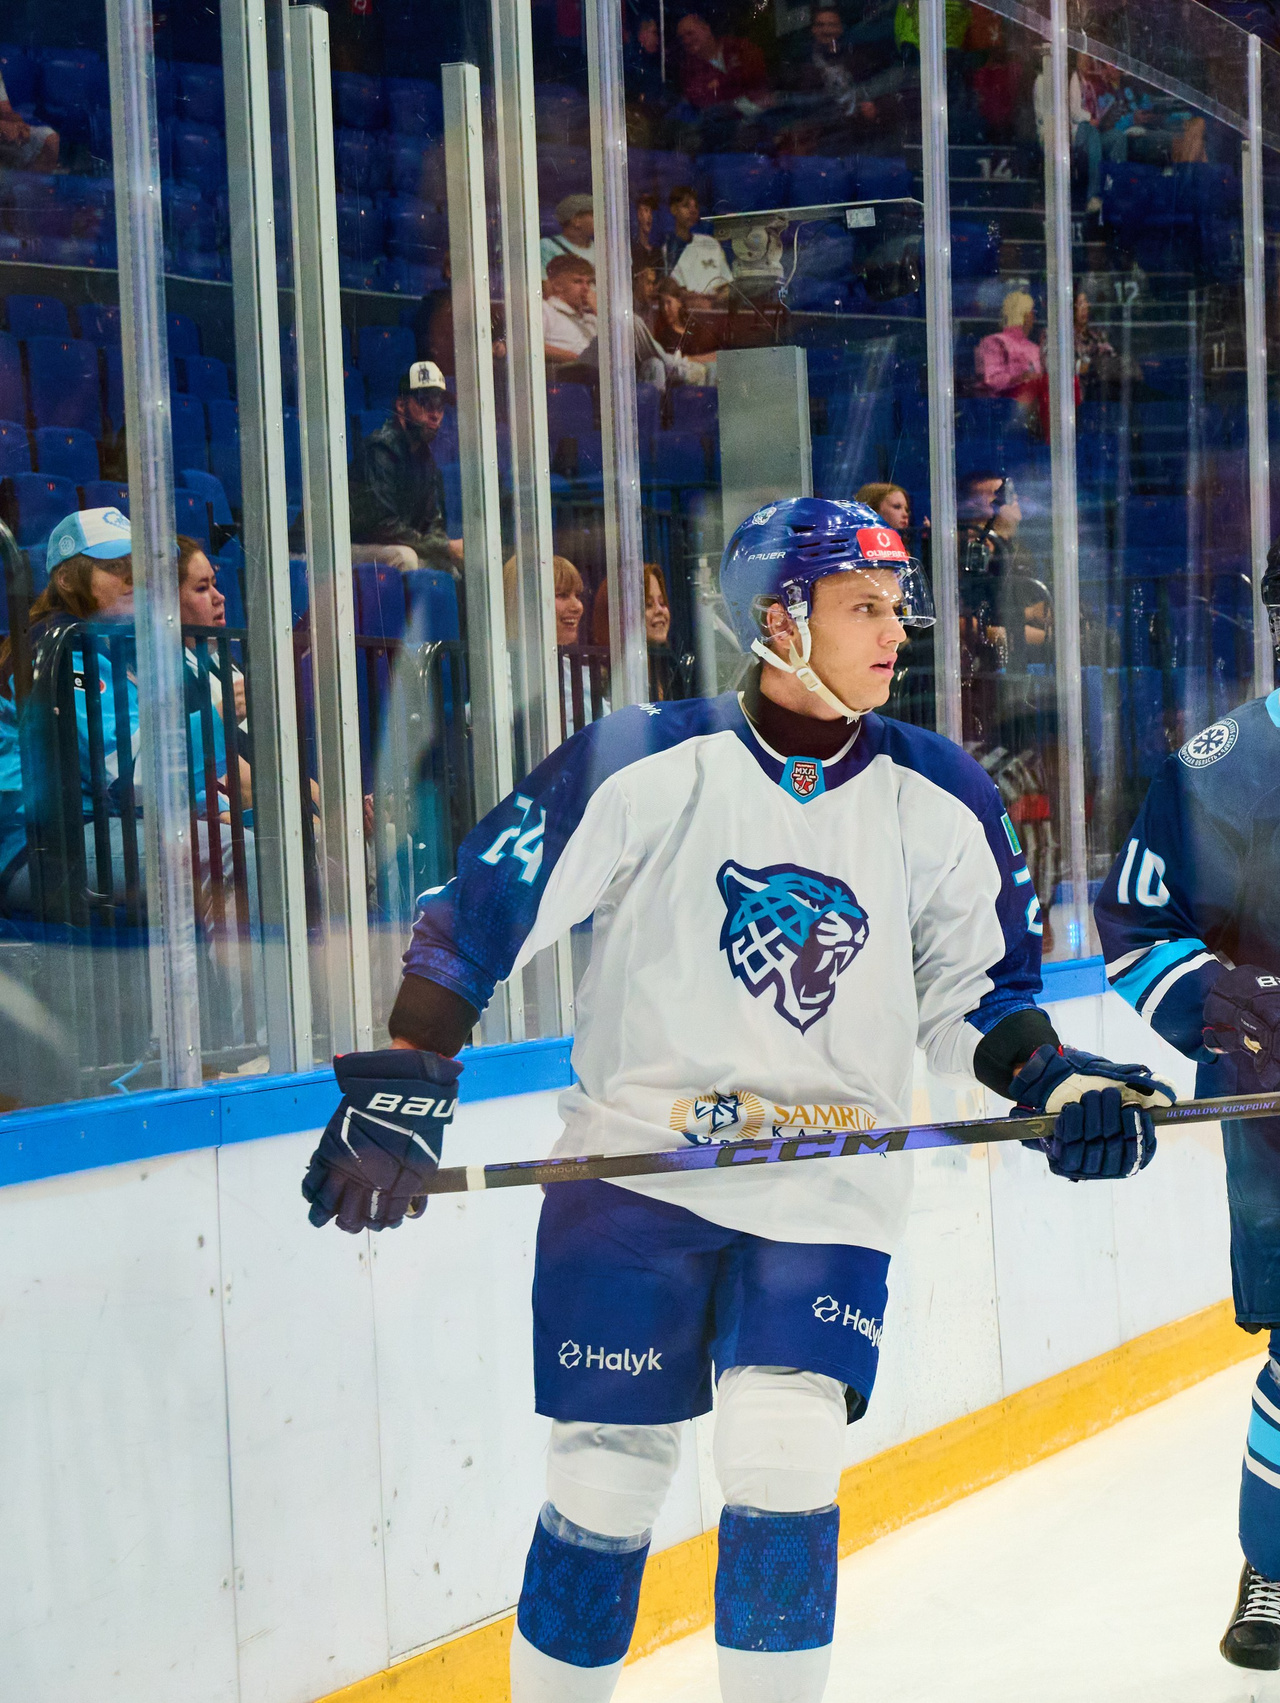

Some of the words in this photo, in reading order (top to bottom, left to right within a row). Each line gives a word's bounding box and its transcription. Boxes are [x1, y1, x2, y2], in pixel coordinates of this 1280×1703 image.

[977, 157, 1012, 181] 14
[1114, 281, 1139, 306] 12
[795, 767, 815, 776] МХЛ
[1117, 837, 1171, 908] 10
[1166, 1106, 1221, 1119] ULTRALOW
[1222, 1100, 1277, 1114] KICKPOINT
[714, 1129, 910, 1168] CCM
[585, 1344, 663, 1377] Halyk
